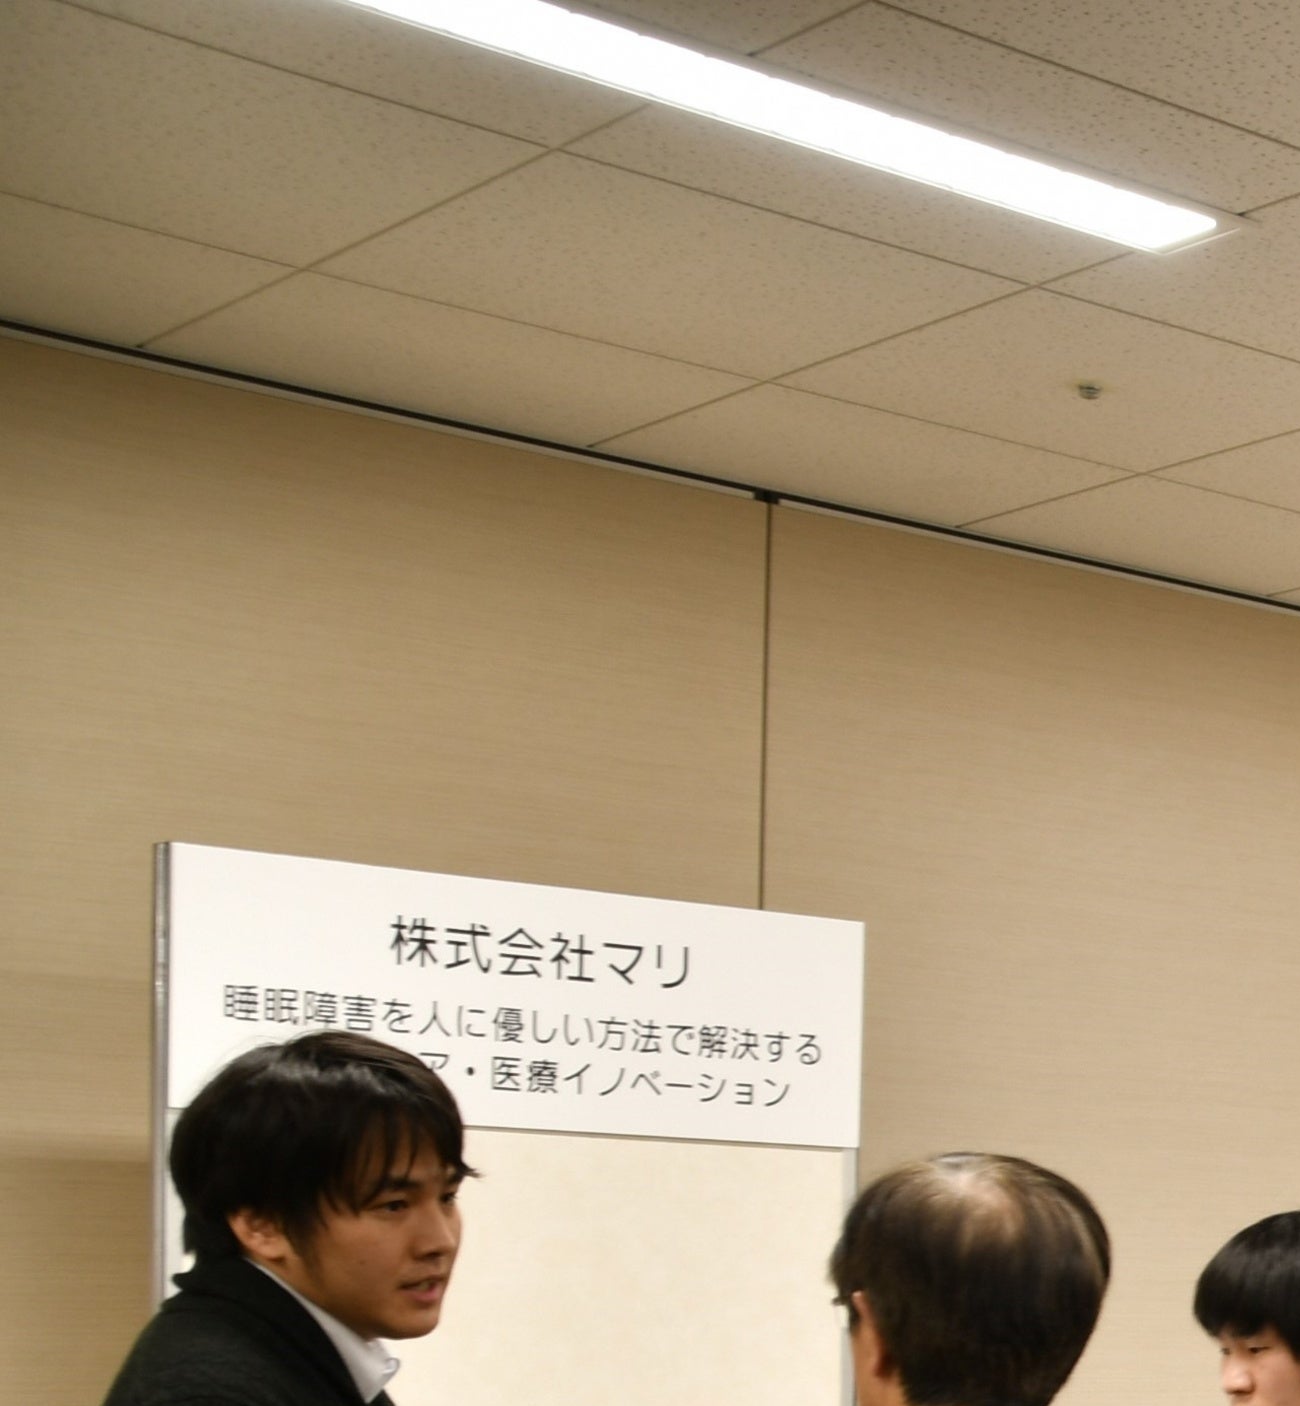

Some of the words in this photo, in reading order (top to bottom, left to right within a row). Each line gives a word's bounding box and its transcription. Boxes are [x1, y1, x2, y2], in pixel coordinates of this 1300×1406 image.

[389, 913, 692, 989] 株式会社マリ
[222, 984, 823, 1067] 睡眠障害を人に優しい方法で解決する
